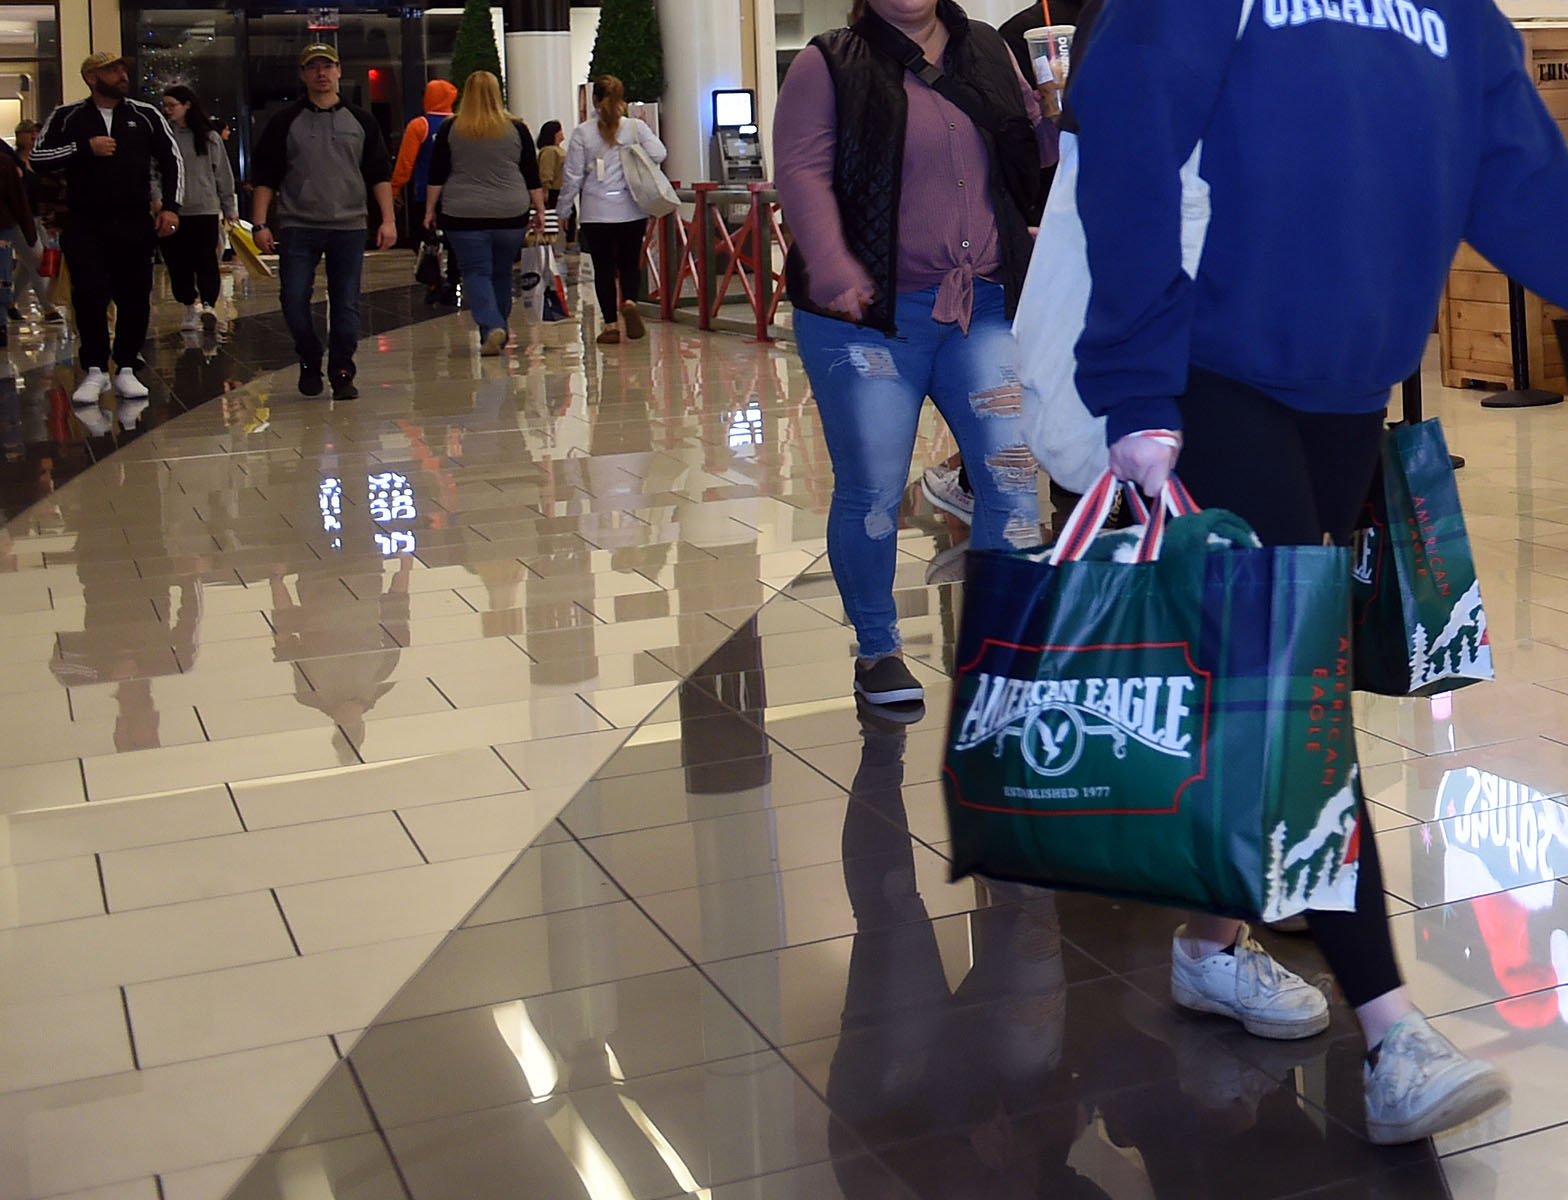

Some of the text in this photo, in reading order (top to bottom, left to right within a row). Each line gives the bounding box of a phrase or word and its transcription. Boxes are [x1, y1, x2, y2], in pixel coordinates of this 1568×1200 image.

[1412, 496, 1452, 597] AMERICAN
[1083, 675, 1195, 751] EAGLE
[1306, 667, 1331, 752] EAGLE
[1321, 636, 1350, 786] AMERICAN
[1082, 786, 1111, 798] 1977
